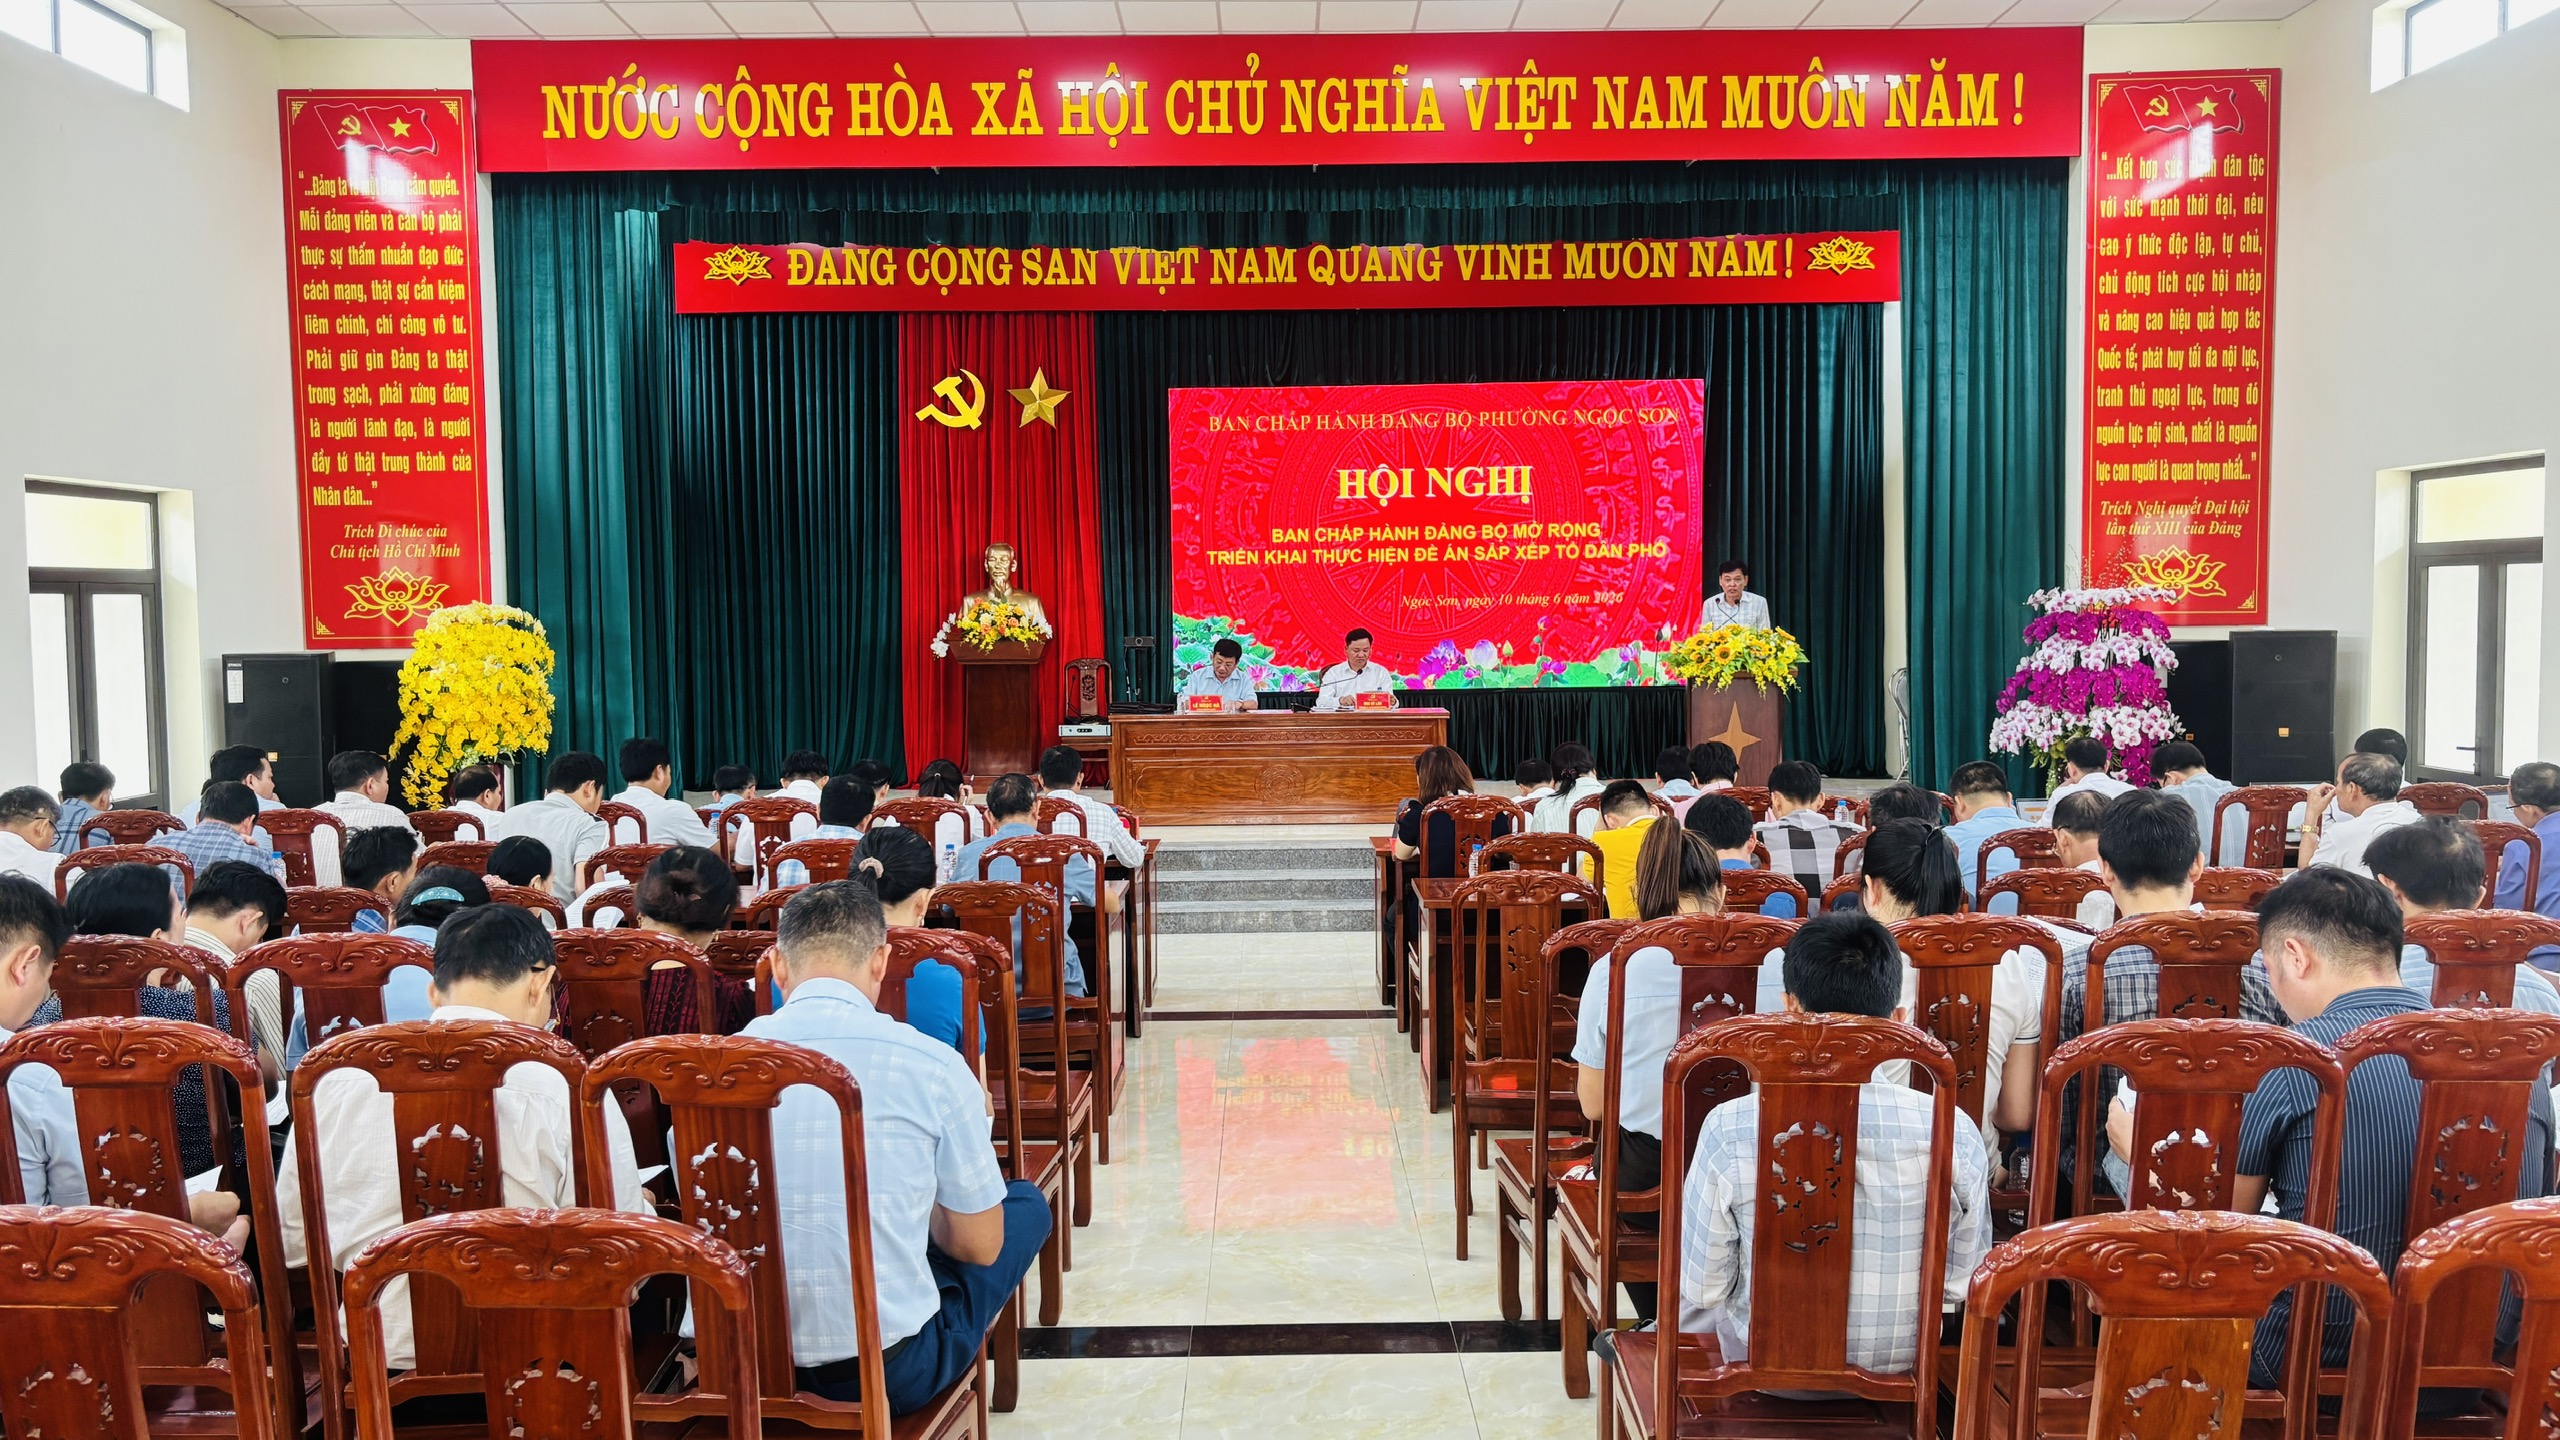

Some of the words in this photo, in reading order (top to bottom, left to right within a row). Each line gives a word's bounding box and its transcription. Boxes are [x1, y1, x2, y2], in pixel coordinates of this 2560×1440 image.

[542, 65, 680, 139] NƯỚC
[694, 66, 833, 152] CỘNG
[847, 62, 953, 136] HÒA
[972, 68, 1044, 135] XÃ
[1058, 62, 1149, 149] HỘI
[1166, 54, 1267, 134] CHỦ
[1280, 64, 1444, 132] NGHĨA
[1460, 59, 1577, 145] VIỆT
[1592, 75, 1708, 130] NAM
[1722, 57, 1870, 129] MUÔN
[1884, 58, 2000, 128] NĂM
[2224, 155, 2242, 177] dân
[2249, 153, 2264, 181] tộc
[338, 176, 347, 195] ta
[429, 171, 459, 198] quyền.
[2101, 196, 2117, 217] với
[2124, 196, 2143, 217] sức
[2151, 194, 2180, 221] mạnh
[2187, 193, 2208, 216] thời
[2216, 193, 2237, 219] đại,
[2244, 192, 2263, 214] nêu
[300, 207, 319, 230] Mỗi
[325, 208, 350, 233] đảng
[355, 210, 377, 230] viên
[381, 210, 394, 230] và
[398, 212, 417, 230] cán
[422, 211, 436, 235] bộ
[440, 209, 462, 233] phải
[302, 246, 324, 269] thực
[331, 247, 343, 269] sự
[349, 242, 375, 265] thấm
[381, 242, 413, 265] nhuần
[419, 246, 438, 269] đạo
[444, 246, 463, 265] đức
[2100, 237, 2119, 255] cao
[2125, 235, 2132, 257] ý
[2138, 234, 2161, 255] thức
[2169, 233, 2188, 259] độc
[2195, 232, 2215, 258] lập,
[2222, 233, 2233, 258] tự
[2240, 229, 2262, 255] chủ,
[1210, 247, 1297, 284] NAM
[1308, 245, 1443, 286] QUANG
[1454, 244, 1552, 280] VINH
[304, 280, 329, 300] cách
[334, 283, 367, 304] mạng,
[372, 279, 392, 304] thật
[397, 279, 409, 304] sự
[414, 276, 433, 300] cần
[438, 279, 465, 304] kiệm
[2099, 310, 2109, 331] và
[2116, 309, 2139, 333] nâng
[2146, 310, 2163, 331] cao
[2170, 307, 2190, 335] hiệu
[2197, 305, 2215, 332] quả
[2221, 308, 2239, 332] hợp
[2245, 305, 2261, 329] tác
[307, 347, 332, 369] Phải
[340, 350, 358, 371] giữ
[366, 349, 383, 371] gìn
[391, 346, 420, 371] Đảng
[427, 351, 438, 369] ta
[446, 349, 468, 373] thật
[2097, 385, 2123, 406] tranh
[2130, 381, 2145, 406] thủ
[2152, 384, 2180, 411] ngoại
[2187, 384, 2206, 411] lực,
[2213, 385, 2239, 407] trong
[2246, 384, 2258, 405] đó
[310, 418, 320, 438] là
[327, 418, 357, 440] người
[364, 418, 387, 438] lãnh
[394, 418, 417, 441] đạo,
[424, 417, 434, 437] là
[441, 417, 470, 439] người
[1209, 416, 1250, 432] BAN
[1316, 411, 1375, 430] HÀNH
[1446, 409, 1472, 432] BỘ
[1479, 406, 1567, 426] PHƯỜNG
[1573, 407, 1633, 429] NGỌC
[1638, 408, 1679, 424] SƠN
[2096, 460, 2110, 486] lực
[2113, 464, 2130, 481] con
[2132, 460, 2157, 483] người
[2160, 459, 2168, 481] là
[2171, 463, 2193, 482] quan
[2196, 460, 2220, 485] trọng
[2222, 452, 2256, 480] nhất...”
[313, 486, 340, 506] Nhân
[1337, 463, 1414, 506] HỘI
[1426, 465, 1533, 503] NGHỊ
[2100, 500, 2132, 515] Trích
[2136, 500, 2166, 518] Nghị
[2168, 496, 2201, 518] quyết
[2204, 500, 2226, 517] Đại
[2230, 499, 2250, 516] hội
[344, 524, 374, 538] Trích
[378, 524, 392, 537] Di
[395, 524, 423, 537] chúc
[426, 525, 447, 537] của
[1272, 528, 1309, 543] BAN
[1370, 524, 1419, 541] HÀNH
[1481, 524, 1508, 542] BỘ
[1548, 521, 1600, 541] RỘNG
[2106, 519, 2125, 536] lần
[2129, 520, 2151, 535] thứ
[2153, 521, 2181, 535] XIII
[2184, 520, 2205, 534] của
[2210, 520, 2242, 538] Đảng
[330, 543, 355, 558] Chủ
[358, 544, 380, 562] tịch
[383, 540, 402, 558] Hồ
[405, 543, 426, 558] Chí
[428, 544, 460, 557] Minh
[1265, 550, 1306, 564] KHAI
[1313, 548, 1362, 567] THỰC
[1368, 546, 1409, 566] HIỆN
[1414, 544, 1438, 562] ĐỀ
[1443, 544, 1468, 561] ÁN
[1585, 540, 1623, 558] DÂN
[1401, 595, 1432, 608] Ngọc
[1436, 594, 1461, 608] Sơn,
[1465, 595, 1494, 608] ngày
[1498, 594, 1512, 604] 10
[1517, 592, 1550, 607] tháng
[1553, 593, 1561, 603] 6
[1564, 593, 1590, 604] năm
[1593, 592, 1623, 603] 2026
